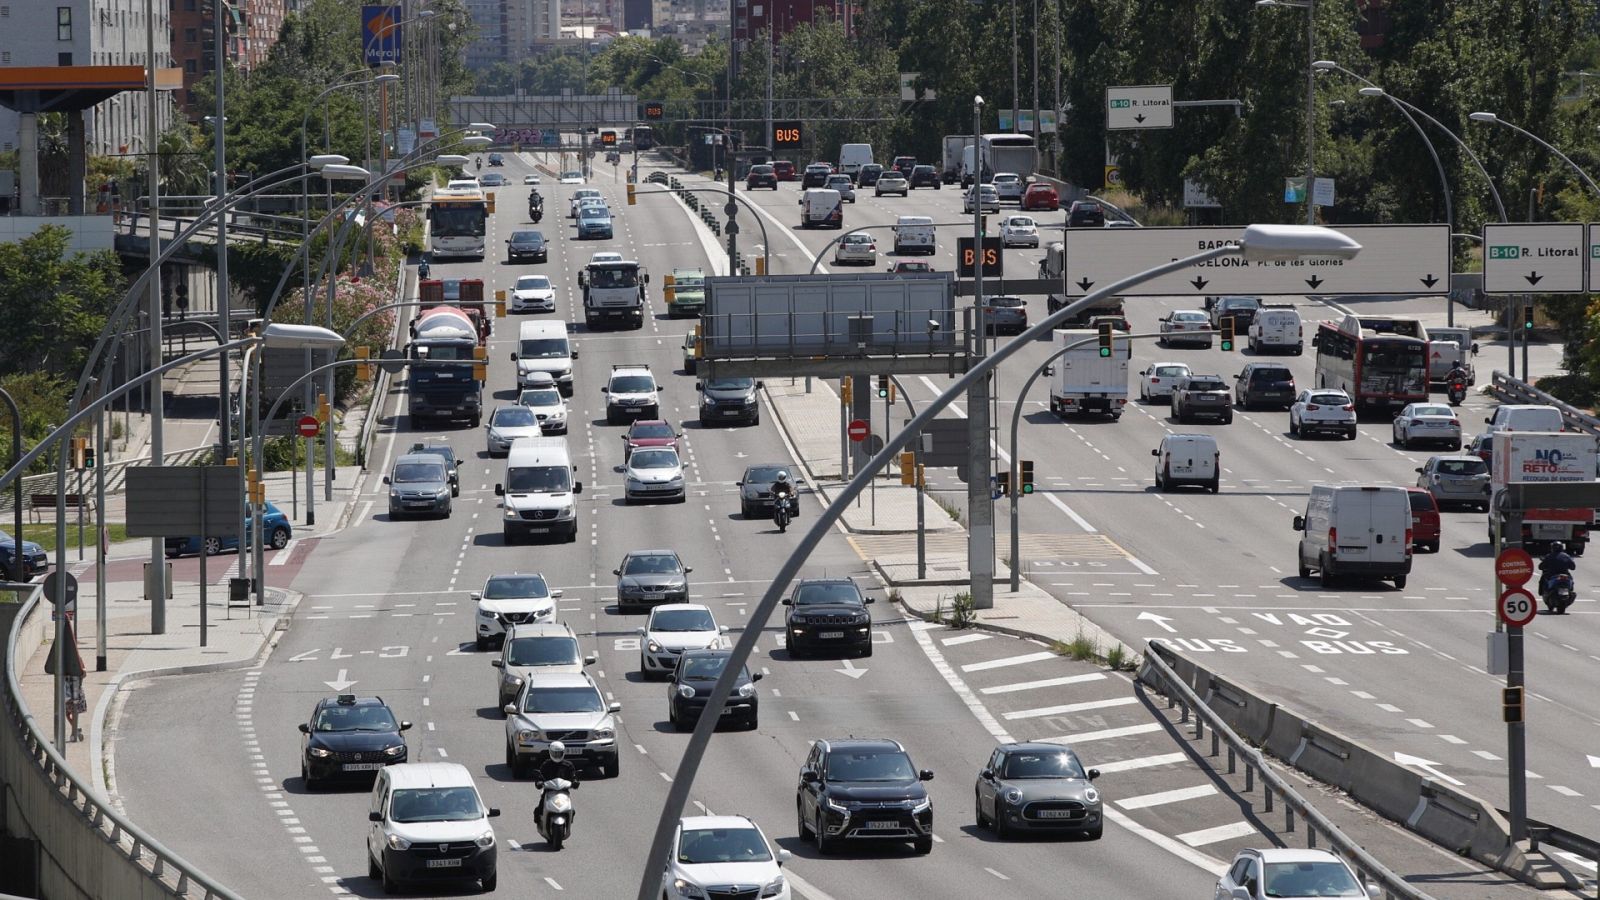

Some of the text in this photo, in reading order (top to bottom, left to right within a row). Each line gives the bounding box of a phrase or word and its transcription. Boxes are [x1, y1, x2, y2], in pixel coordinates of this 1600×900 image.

[1111, 100, 1130, 108] B-10
[1142, 99, 1170, 107] Litoral
[776, 129, 800, 142] BUS
[964, 249, 997, 266] BUS
[1490, 247, 1580, 258] B-10 R. Litoral
[1523, 464, 1558, 473] RETO
[1502, 560, 1527, 568] CONTROL
[1507, 600, 1529, 614] 50
[1251, 612, 1353, 626] VAO
[1298, 640, 1411, 655] BUS
